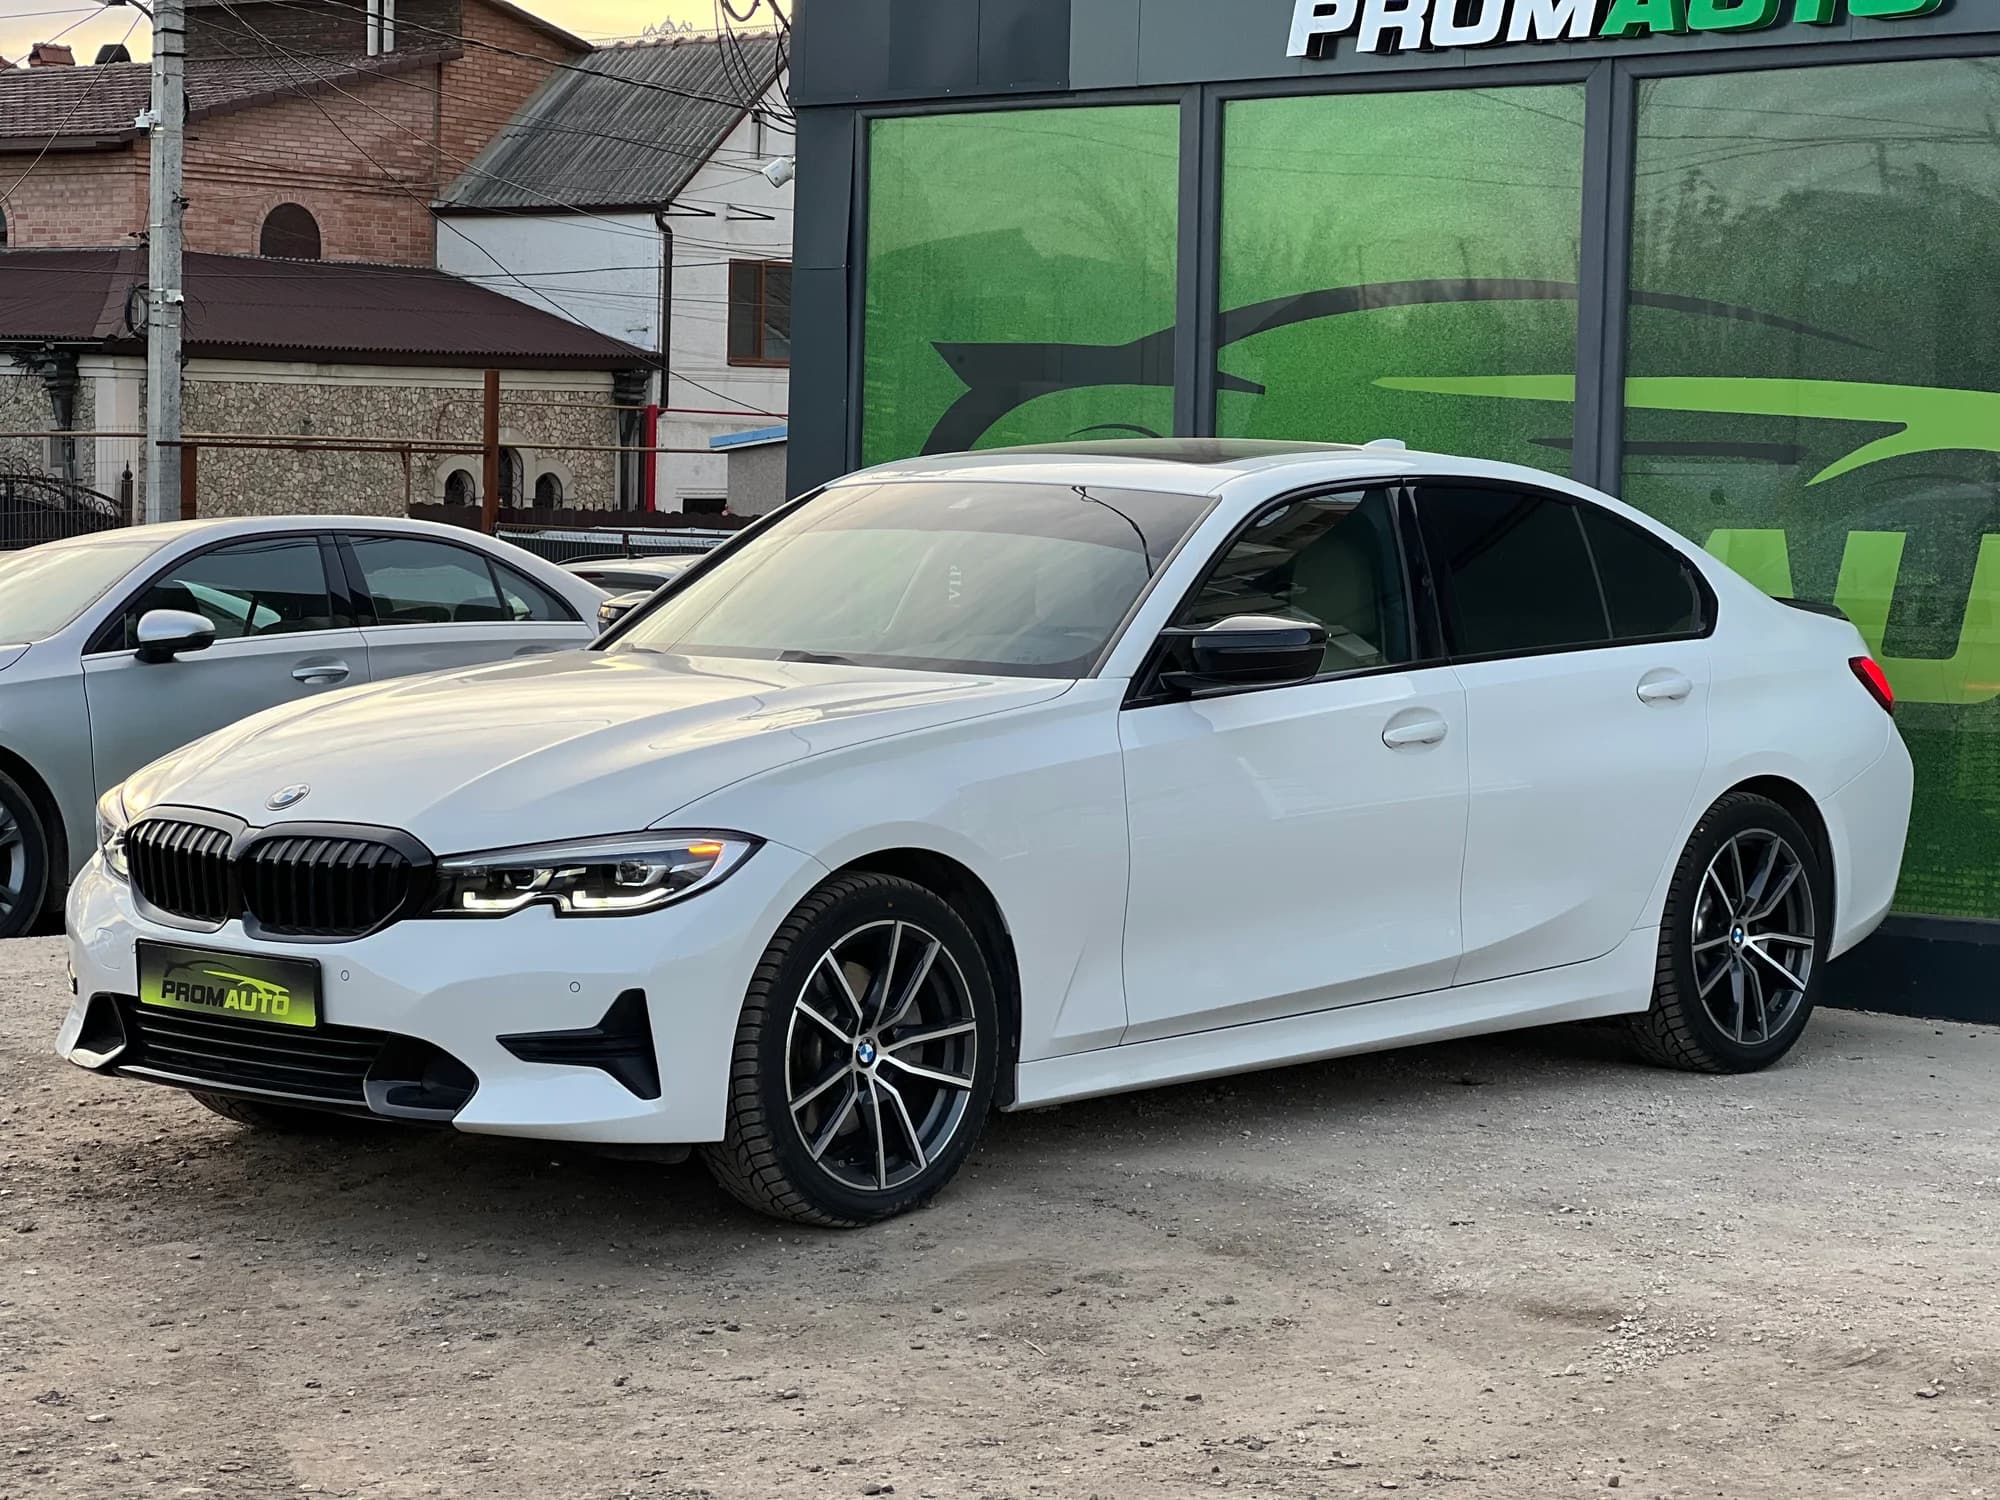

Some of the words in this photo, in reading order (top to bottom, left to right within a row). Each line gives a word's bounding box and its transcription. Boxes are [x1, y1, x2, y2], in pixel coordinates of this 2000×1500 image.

[1286, 0, 1938, 57] PROMA
[948, 564, 961, 601] VIP
[161, 979, 290, 1016] PROMAUTO
